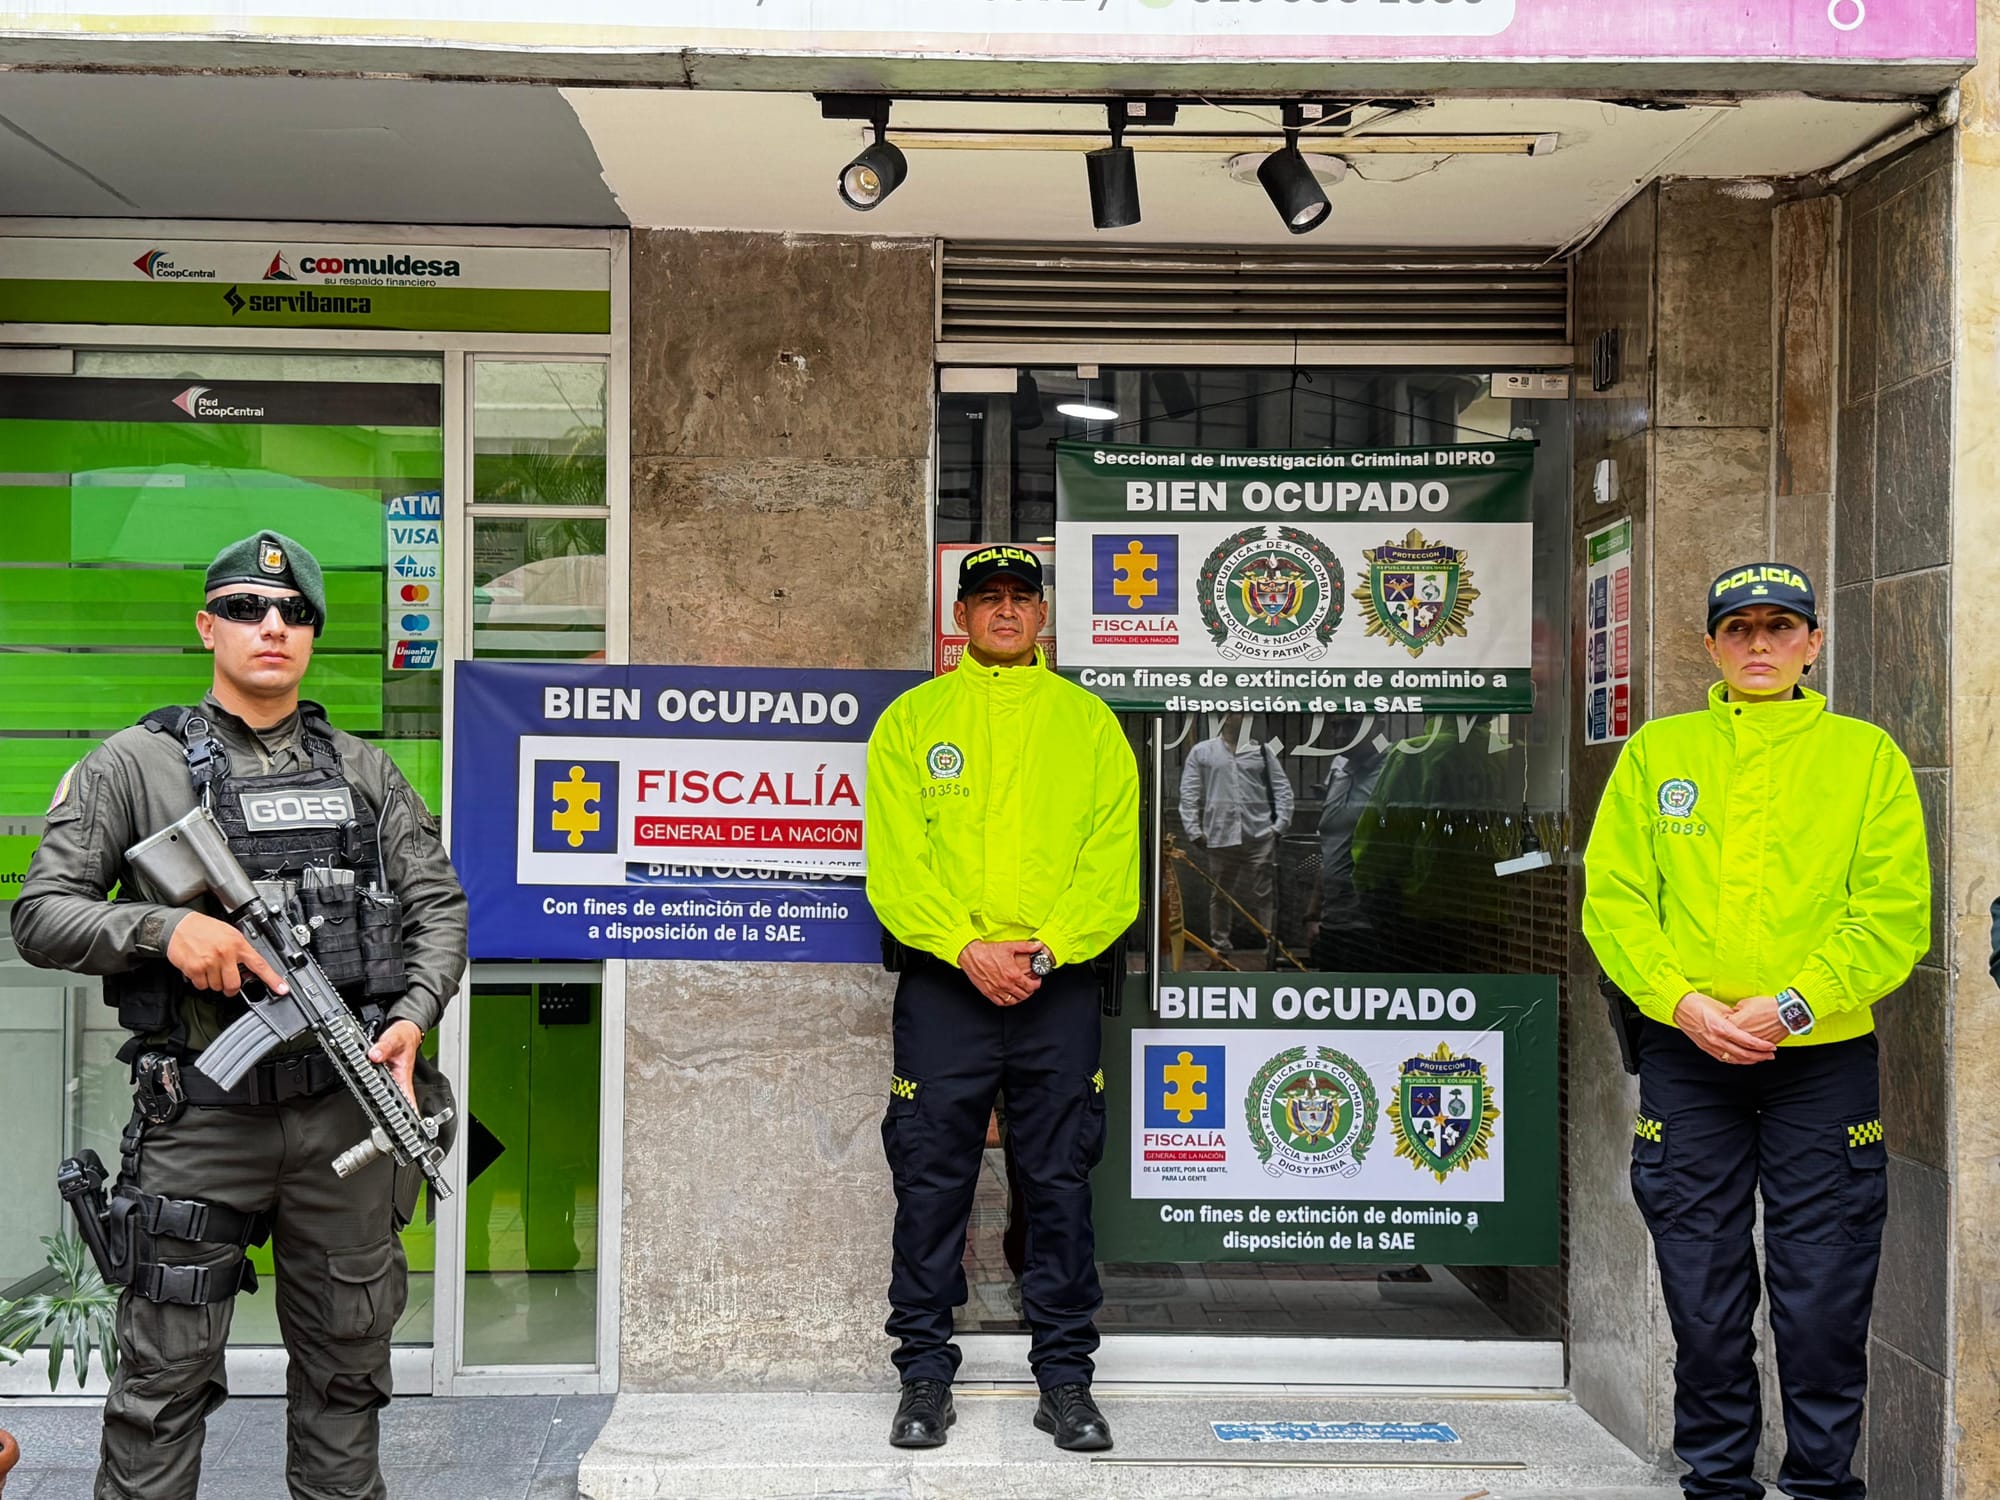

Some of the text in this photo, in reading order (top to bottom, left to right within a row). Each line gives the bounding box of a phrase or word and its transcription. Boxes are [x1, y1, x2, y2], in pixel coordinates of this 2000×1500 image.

[156, 268, 216, 280] CoopCentral
[157, 260, 175, 269] Red
[300, 254, 460, 277] coomuldesa
[324, 277, 437, 287] su respaldo financiero
[249, 289, 371, 314] servibanca
[198, 398, 218, 407] Red
[198, 406, 264, 417] CoopCentral
[1093, 450, 1496, 470] Seccional de Investigación Criminal DIPRO
[388, 495, 440, 515] ATM
[1126, 481, 1450, 512] BIEN OCUPADO
[391, 528, 439, 544] VISA
[405, 566, 436, 577] PLUS
[1266, 541, 1283, 549] DE
[1294, 547, 1329, 601] COLOMBIA
[1092, 617, 1178, 631] FISCALÍA
[1273, 612, 1324, 644] NACIONAL
[397, 647, 434, 657] UnionPay
[1235, 642, 1311, 658] DIOS Y PATRIA
[1080, 669, 1507, 688] Con fines de extinción de dominio a
[544, 686, 859, 725] BIEN OCUPADO
[1165, 695, 1424, 713] disposición de la SAE
[637, 764, 862, 807] FISCALÍA
[250, 795, 347, 823] GOES
[640, 822, 858, 843] GENERAL DE LA NACIÓN
[543, 897, 849, 919] Con fines de extinción de dominio
[588, 923, 806, 943] a disposición de la SAE.
[1159, 986, 1477, 1021] BIEN OCUPADO
[1306, 1060, 1321, 1068] DE
[1331, 1067, 1363, 1120] COLOMBIA
[1144, 1131, 1226, 1147] FISCALÍA
[1312, 1130, 1359, 1161] NACIONAL
[1199, 1151, 1224, 1159] NACIÓN
[1278, 1158, 1347, 1174] DIOS Y PATRIA
[1160, 1204, 1479, 1225] Con fines de extinción de dominio a
[1223, 1231, 1416, 1252] disposición de la SAE
